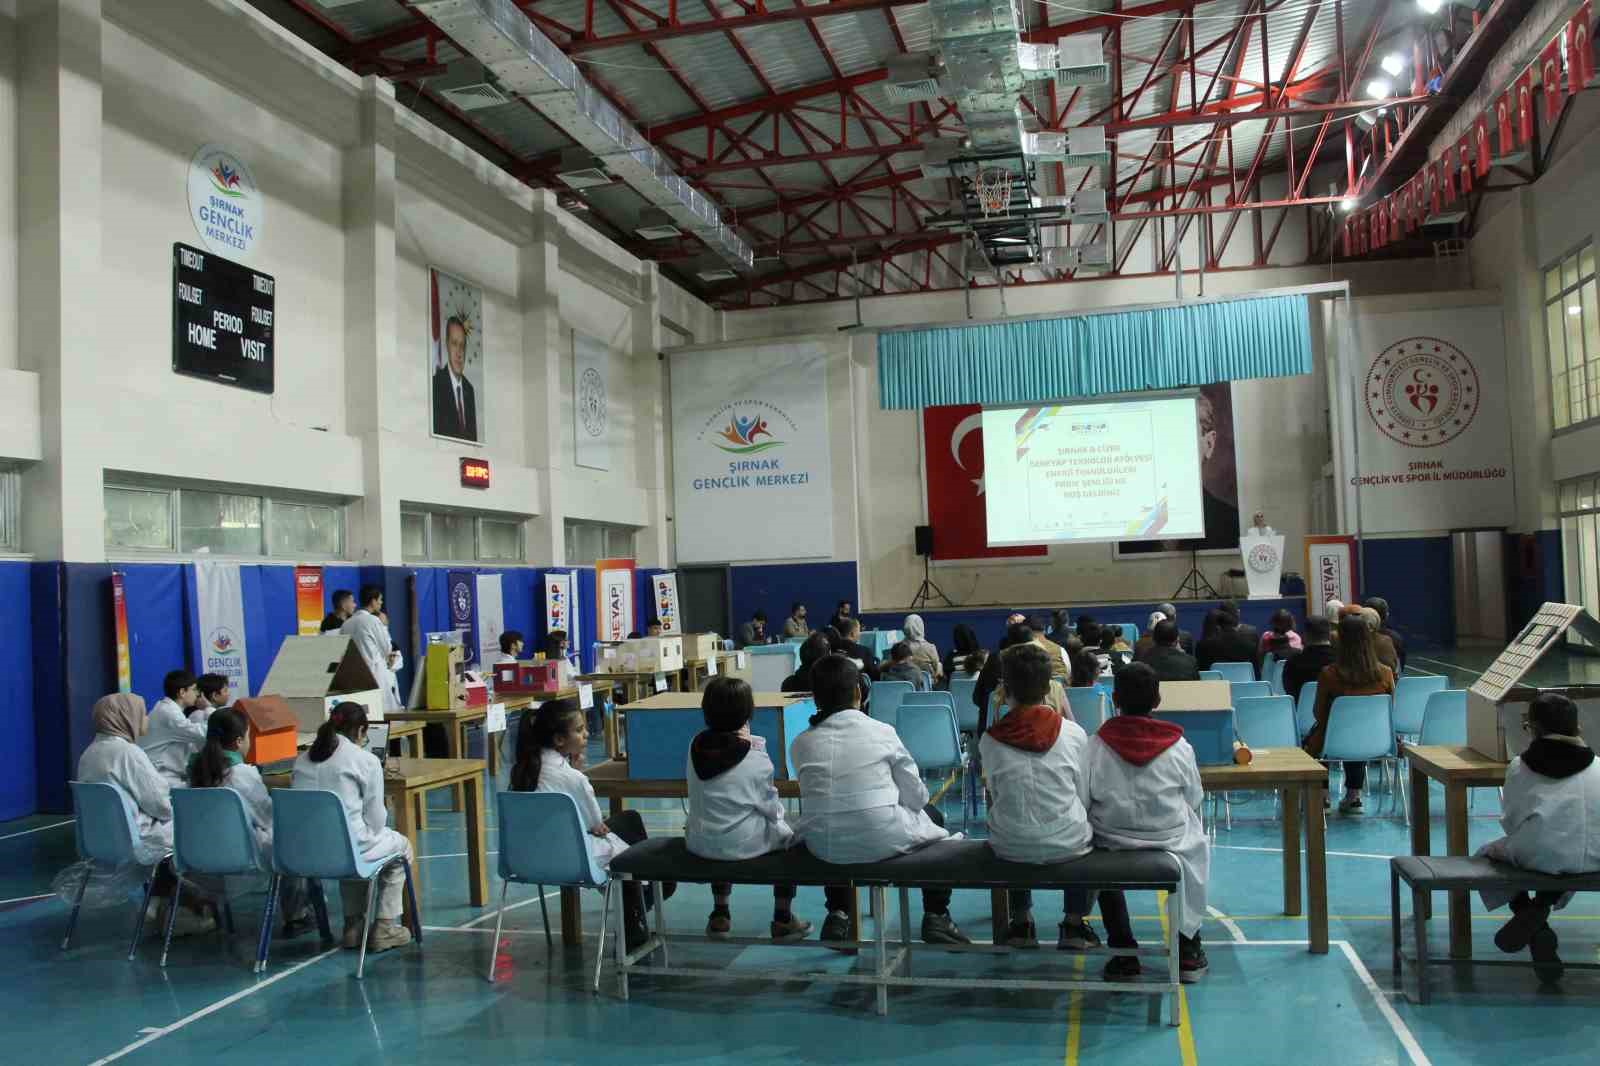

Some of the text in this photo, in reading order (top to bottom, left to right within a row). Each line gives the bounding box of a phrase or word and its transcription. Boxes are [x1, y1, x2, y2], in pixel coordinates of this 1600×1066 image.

[180, 248, 204, 272] TIMEOUT
[213, 310, 243, 334] PERIOD
[188, 322, 217, 350] HOME
[241, 336, 267, 362] VISIT
[729, 459, 779, 474] ŞIRNAK
[1408, 461, 1443, 471] ŞIRNAK
[756, 472, 809, 486] MERKEZİ
[1392, 475, 1404, 484] VE
[1406, 473, 1431, 483] SPOR
[1433, 471, 1441, 481] İL
